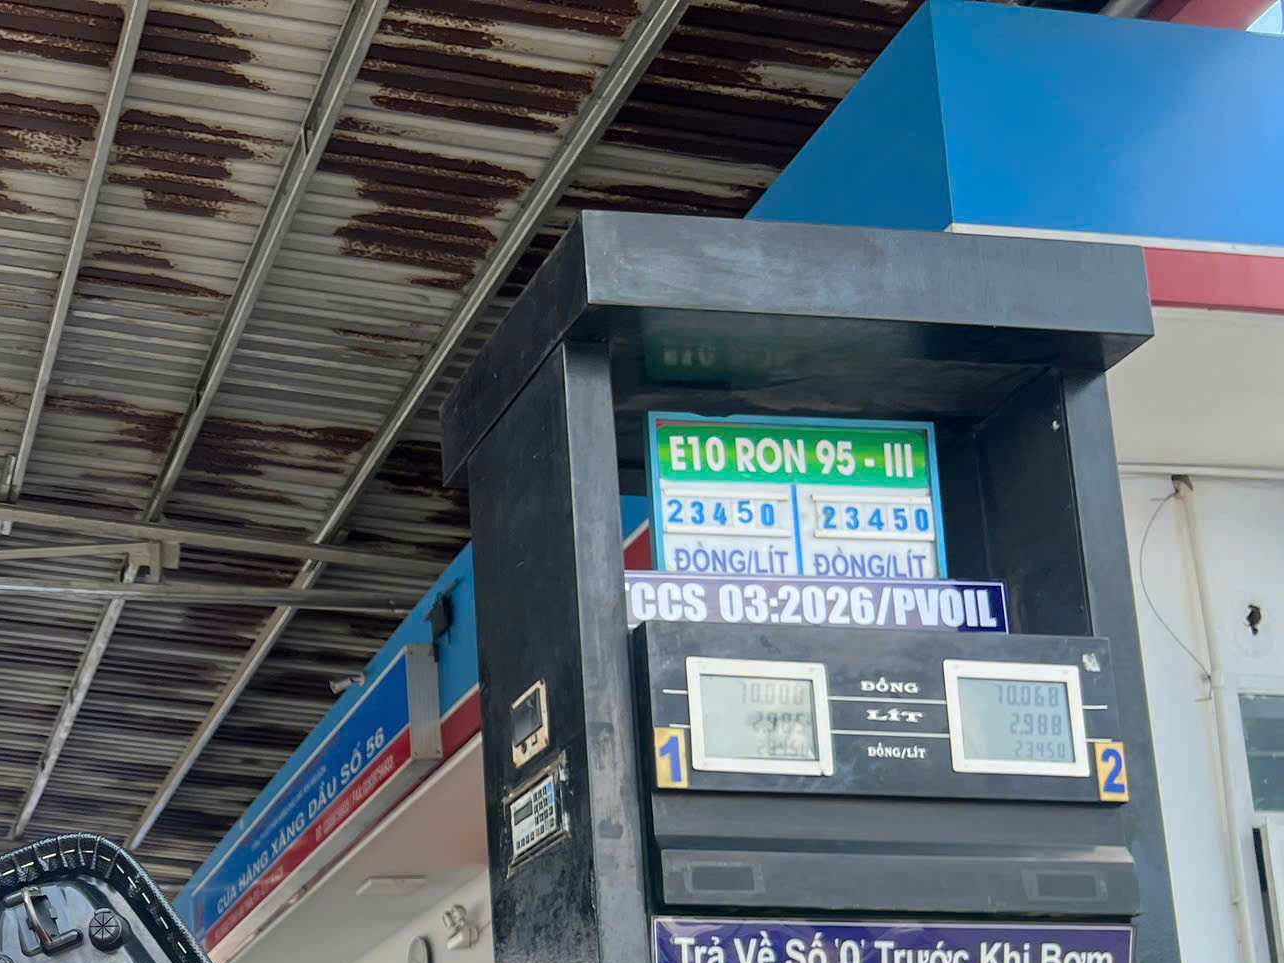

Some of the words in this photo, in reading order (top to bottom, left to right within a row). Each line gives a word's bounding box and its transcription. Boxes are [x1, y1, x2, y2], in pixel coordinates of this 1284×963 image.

[669, 436, 726, 472] E10
[735, 437, 807, 474] RON
[816, 440, 856, 476] 95
[884, 443, 914, 478] III
[667, 499, 775, 526] 23450
[822, 506, 929, 532] 23450
[719, 583, 997, 628] 03:2026/PVOIL
[340, 741, 362, 785] SỐ
[366, 726, 385, 759] 56
[659, 735, 682, 782] 1
[1100, 748, 1125, 793] 2
